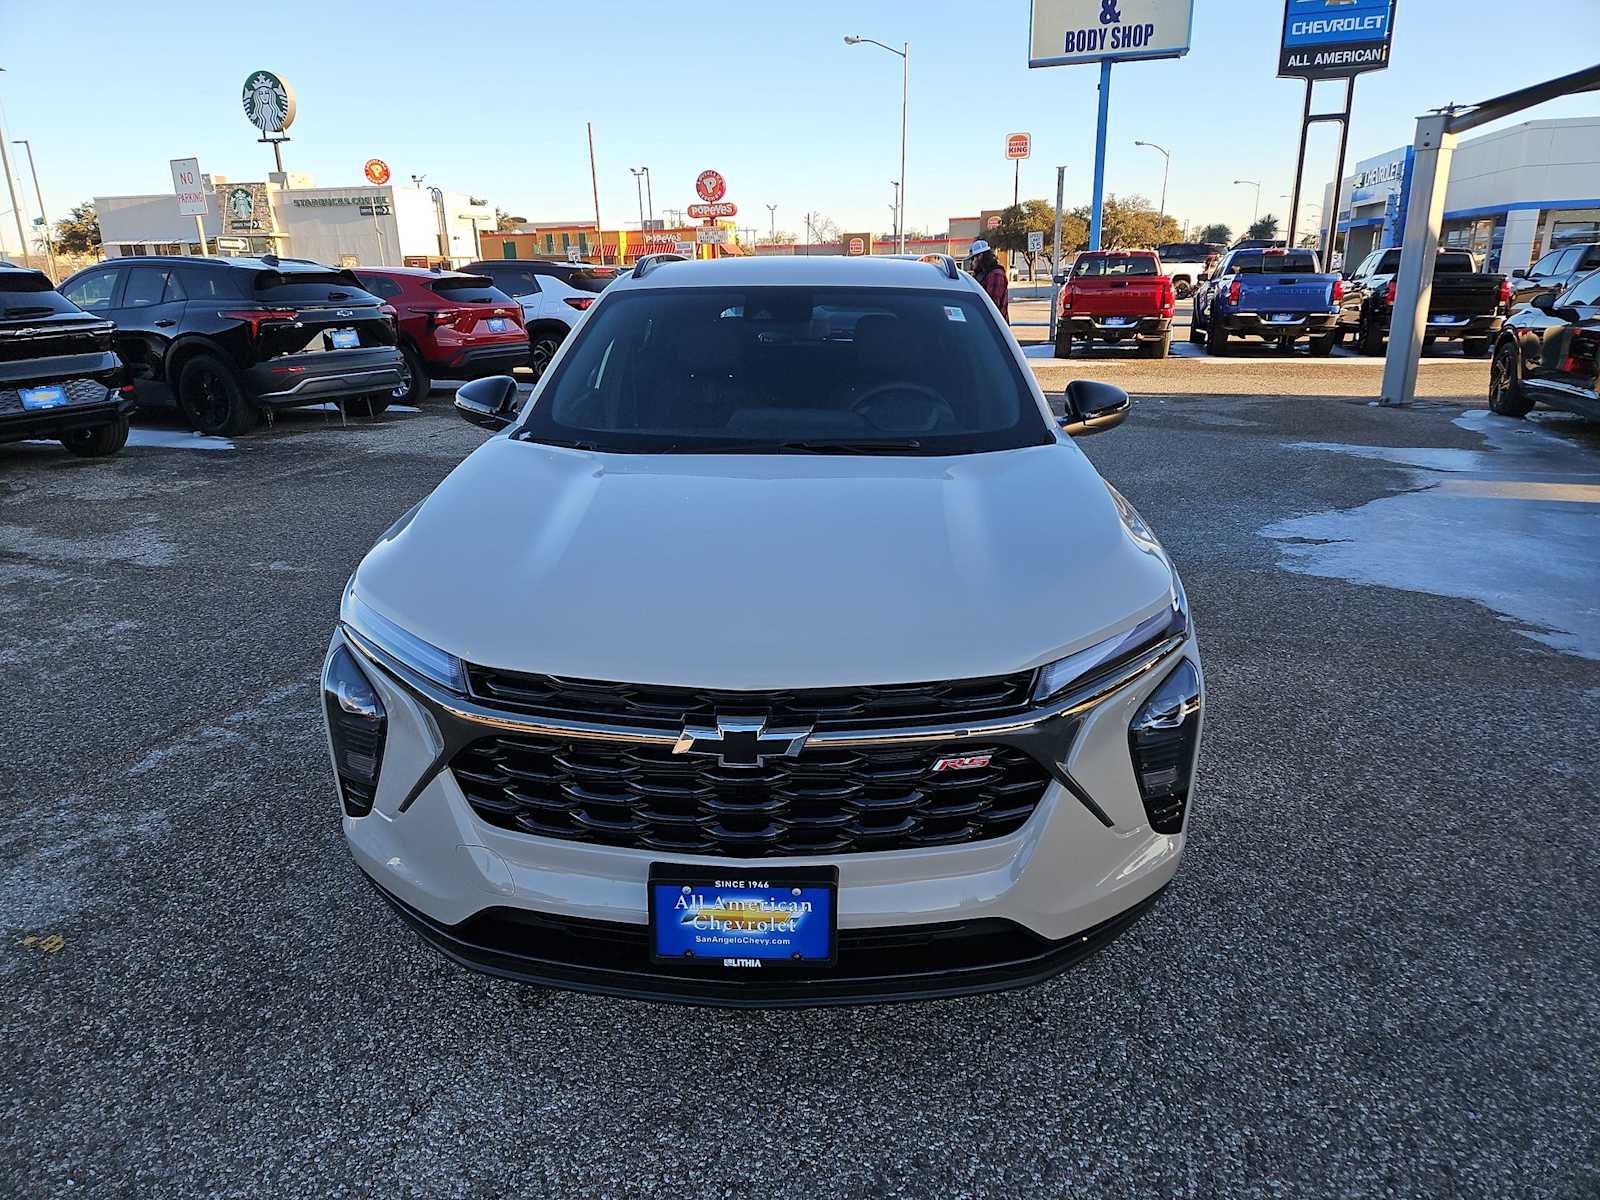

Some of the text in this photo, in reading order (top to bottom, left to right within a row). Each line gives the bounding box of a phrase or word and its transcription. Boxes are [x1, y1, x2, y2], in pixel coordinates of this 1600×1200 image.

[1099, 0, 1121, 24] &
[1291, 15, 1385, 36] CHEVROLET
[1065, 24, 1154, 53] BODY SHOP
[1287, 49, 1382, 67] ALL AMERICAN
[180, 171, 194, 184] NO
[177, 192, 203, 203] PARKING
[1031, 242, 1042, 250] 35
[714, 880, 770, 889] SINCE 1946
[674, 894, 813, 913] All American
[693, 915, 797, 933] Chevrolet
[695, 935, 791, 946] SanAngeloChevy.com
[731, 958, 762, 968] LITHIA
